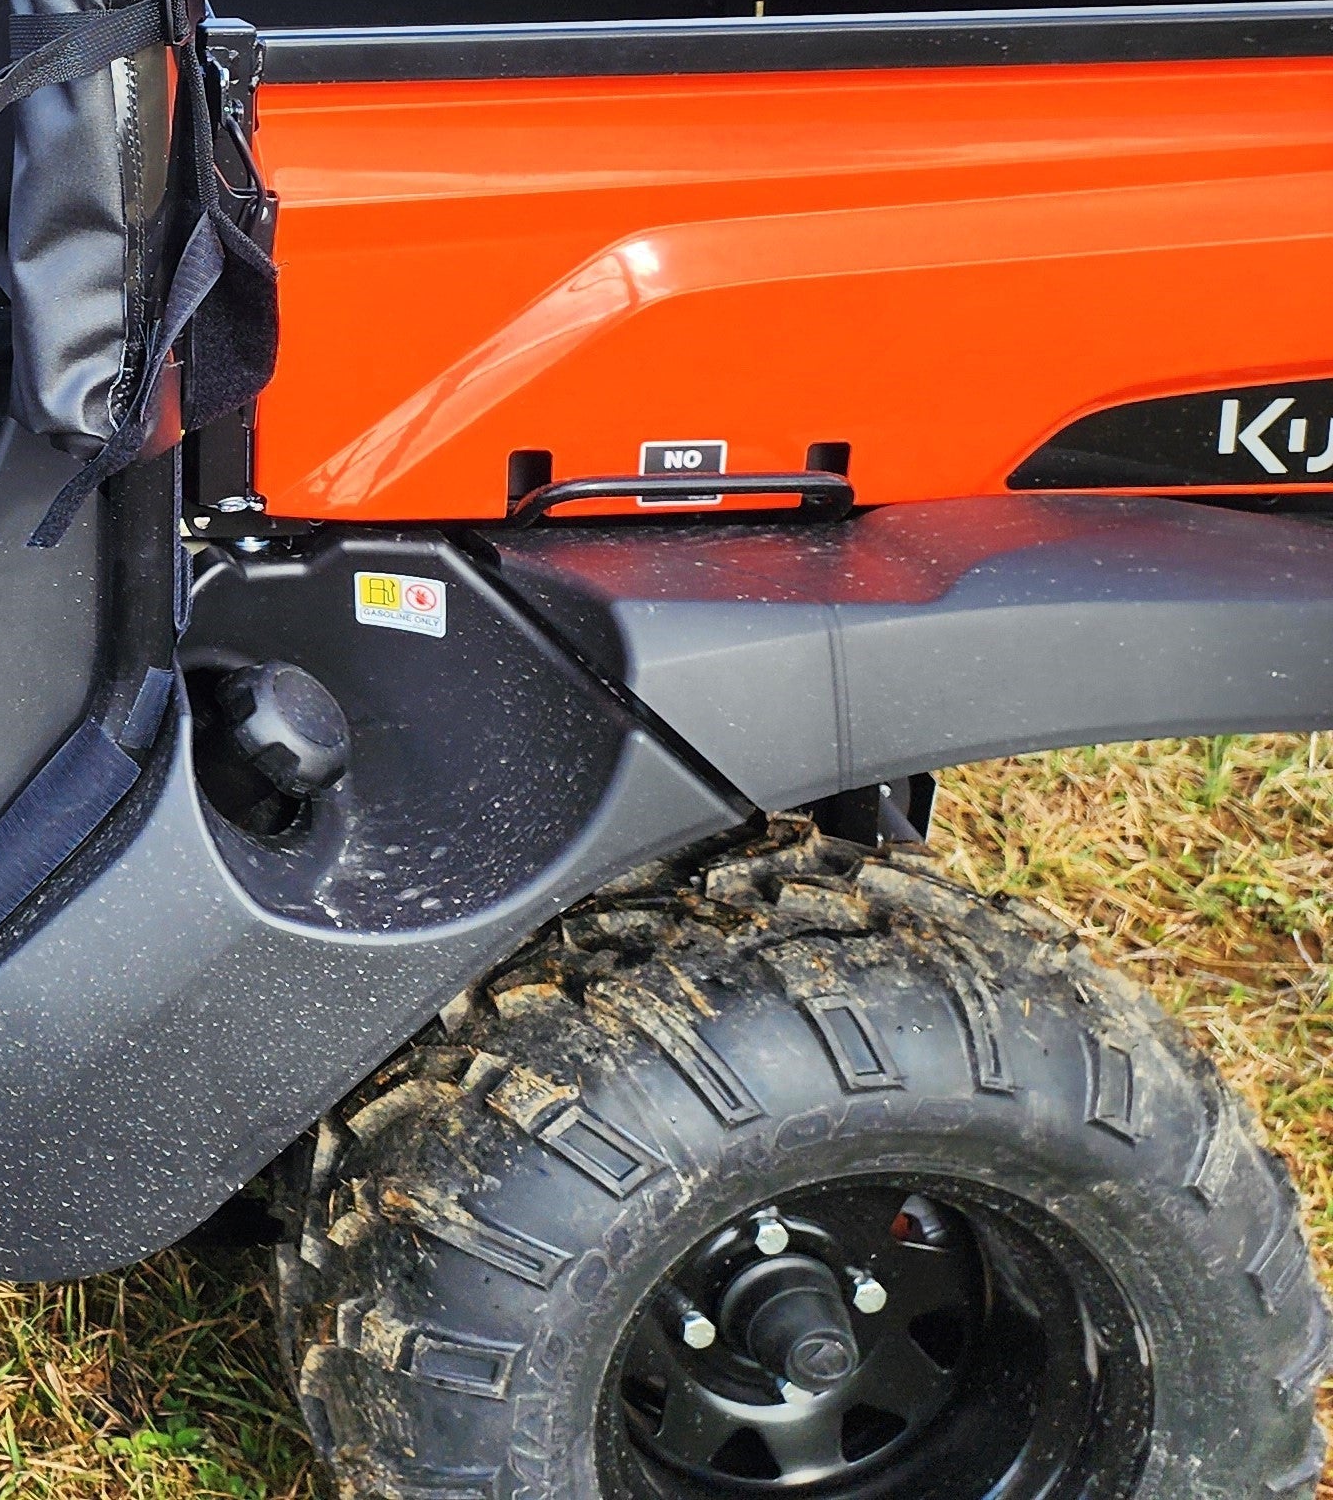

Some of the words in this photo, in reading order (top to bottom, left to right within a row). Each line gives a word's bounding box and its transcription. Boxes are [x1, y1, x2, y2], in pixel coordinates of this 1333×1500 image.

[663, 449, 703, 469] NO
[363, 608, 412, 623] GASOLINE
[414, 615, 440, 627] ONLY
